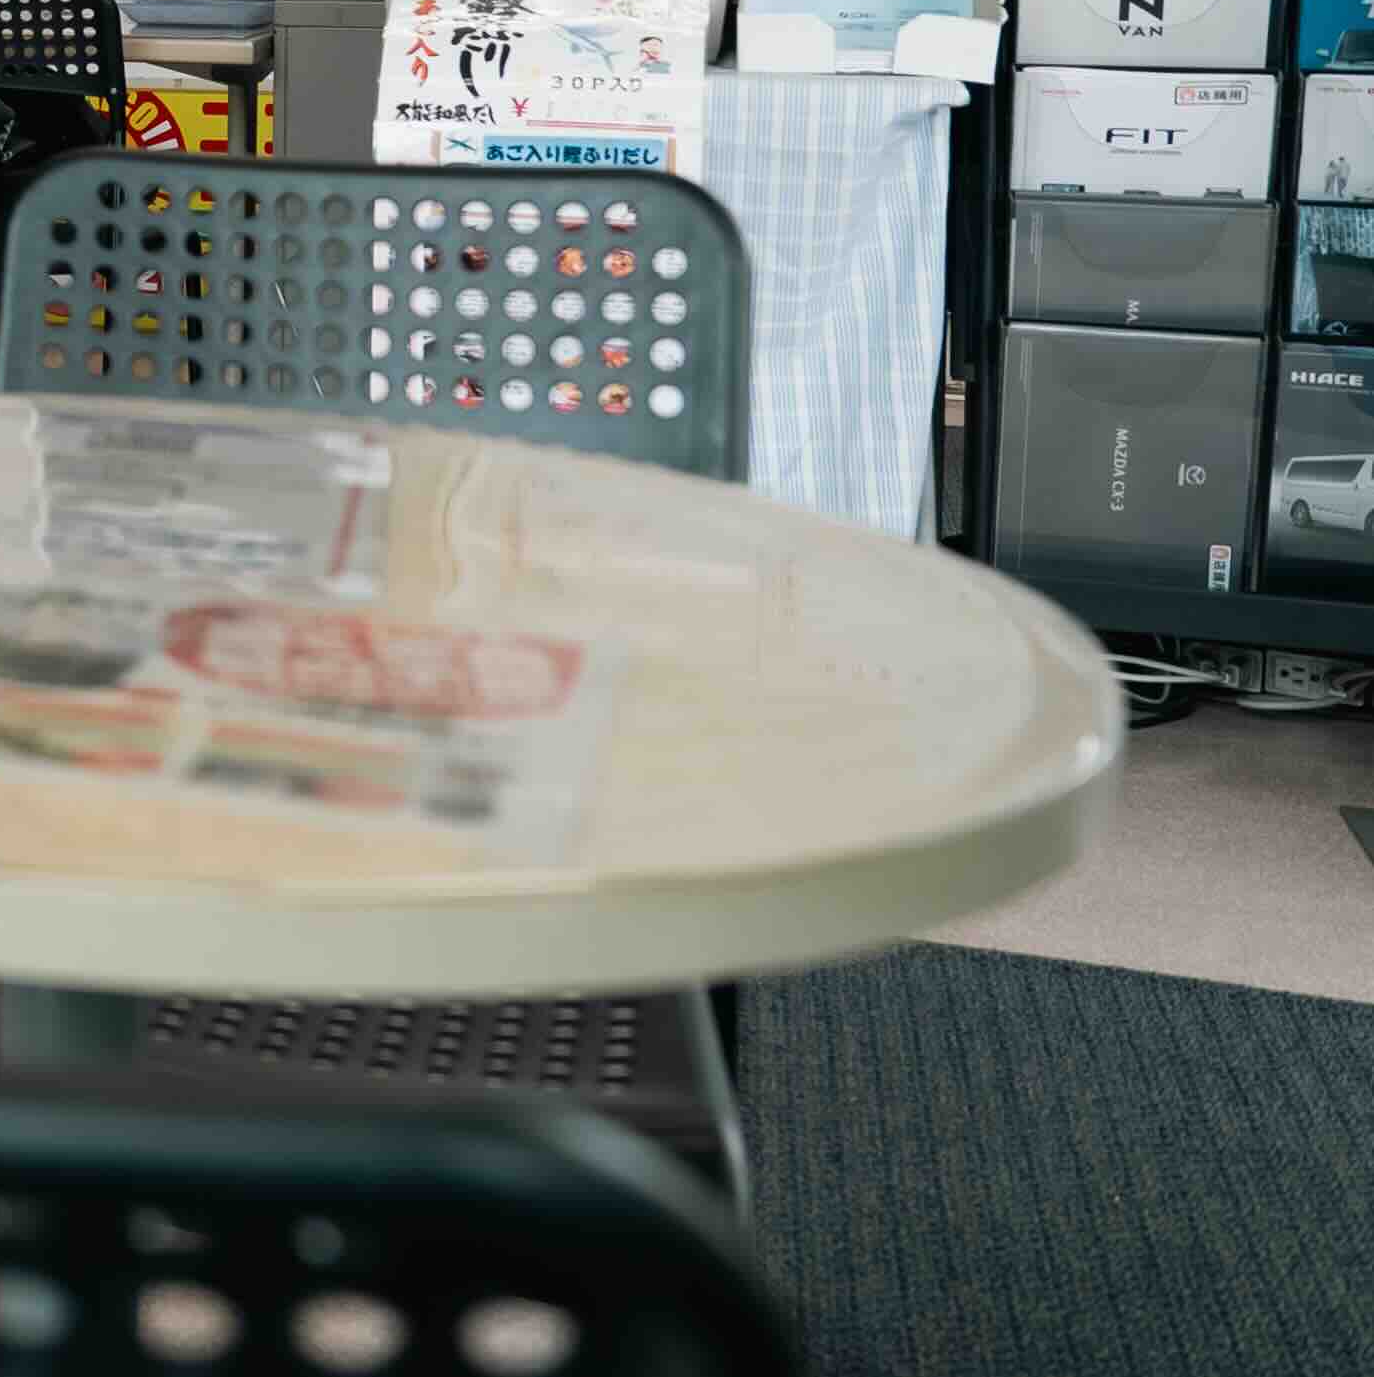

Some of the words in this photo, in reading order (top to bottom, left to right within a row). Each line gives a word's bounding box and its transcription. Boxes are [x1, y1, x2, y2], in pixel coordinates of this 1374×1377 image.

[1118, 24, 1164, 37] VAN
[1105, 127, 1189, 145] FIT
[1290, 369, 1364, 388] HIACE
[1112, 427, 1129, 482] MAZDA
[1110, 482, 1126, 513] CX-3
